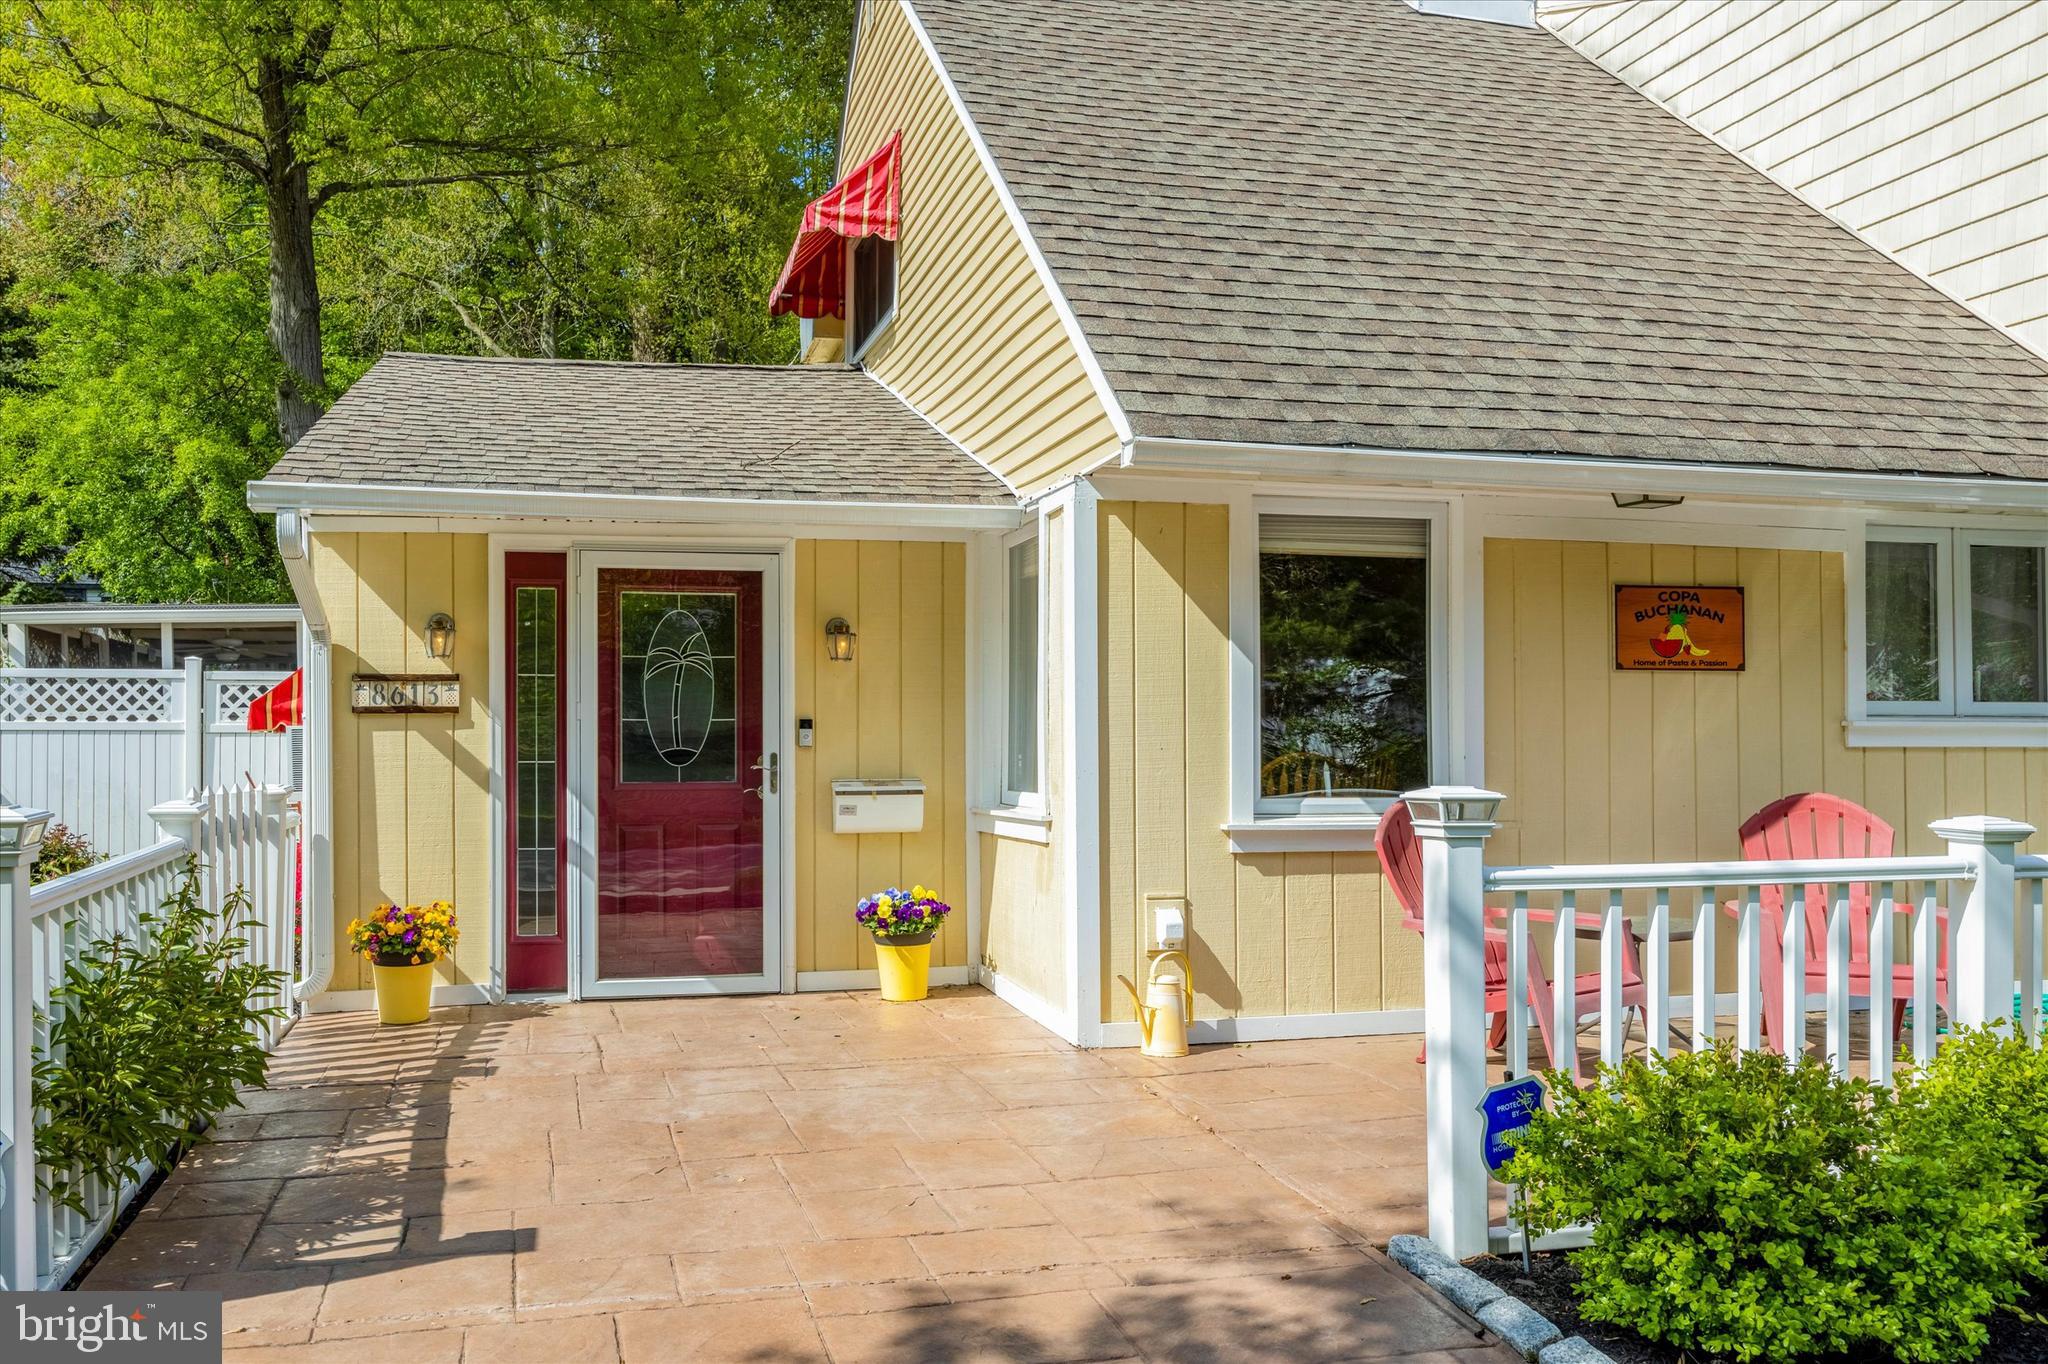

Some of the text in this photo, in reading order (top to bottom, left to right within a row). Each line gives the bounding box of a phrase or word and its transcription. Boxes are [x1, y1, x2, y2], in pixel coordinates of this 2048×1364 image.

[1657, 590, 1701, 604] COPA
[1633, 604, 1726, 624] BUCHANAN
[1633, 659, 1656, 667] Home
[1658, 659, 1667, 667] of
[1690, 659, 1697, 667] &
[1698, 659, 1728, 667] Passion
[371, 682, 440, 706] 8613
[1496, 1097, 1533, 1113] PROTECD
[1511, 1110, 1520, 1118] BY
